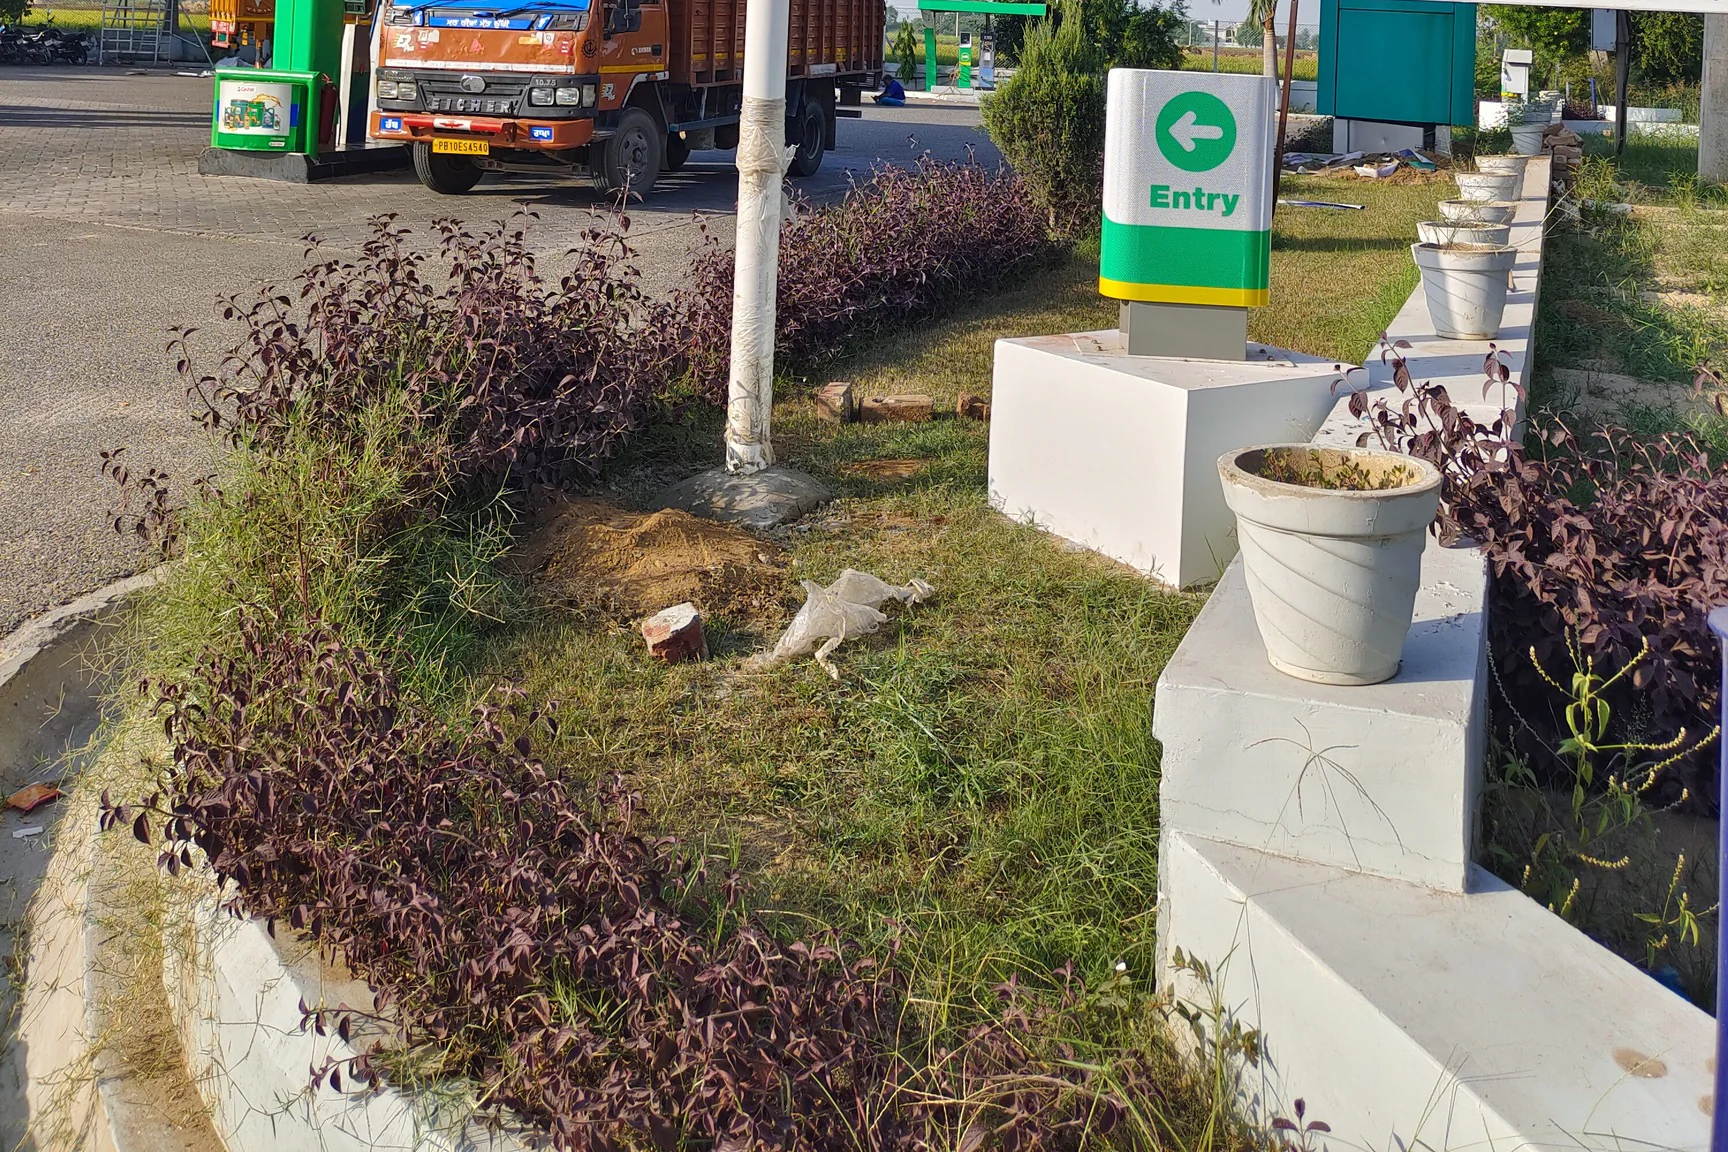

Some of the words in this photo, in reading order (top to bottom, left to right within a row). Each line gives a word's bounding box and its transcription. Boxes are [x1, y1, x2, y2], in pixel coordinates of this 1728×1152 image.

[430, 97, 510, 114] EICHER
[438, 141, 488, 153] PB10ES4540
[1150, 184, 1241, 217] Entry
